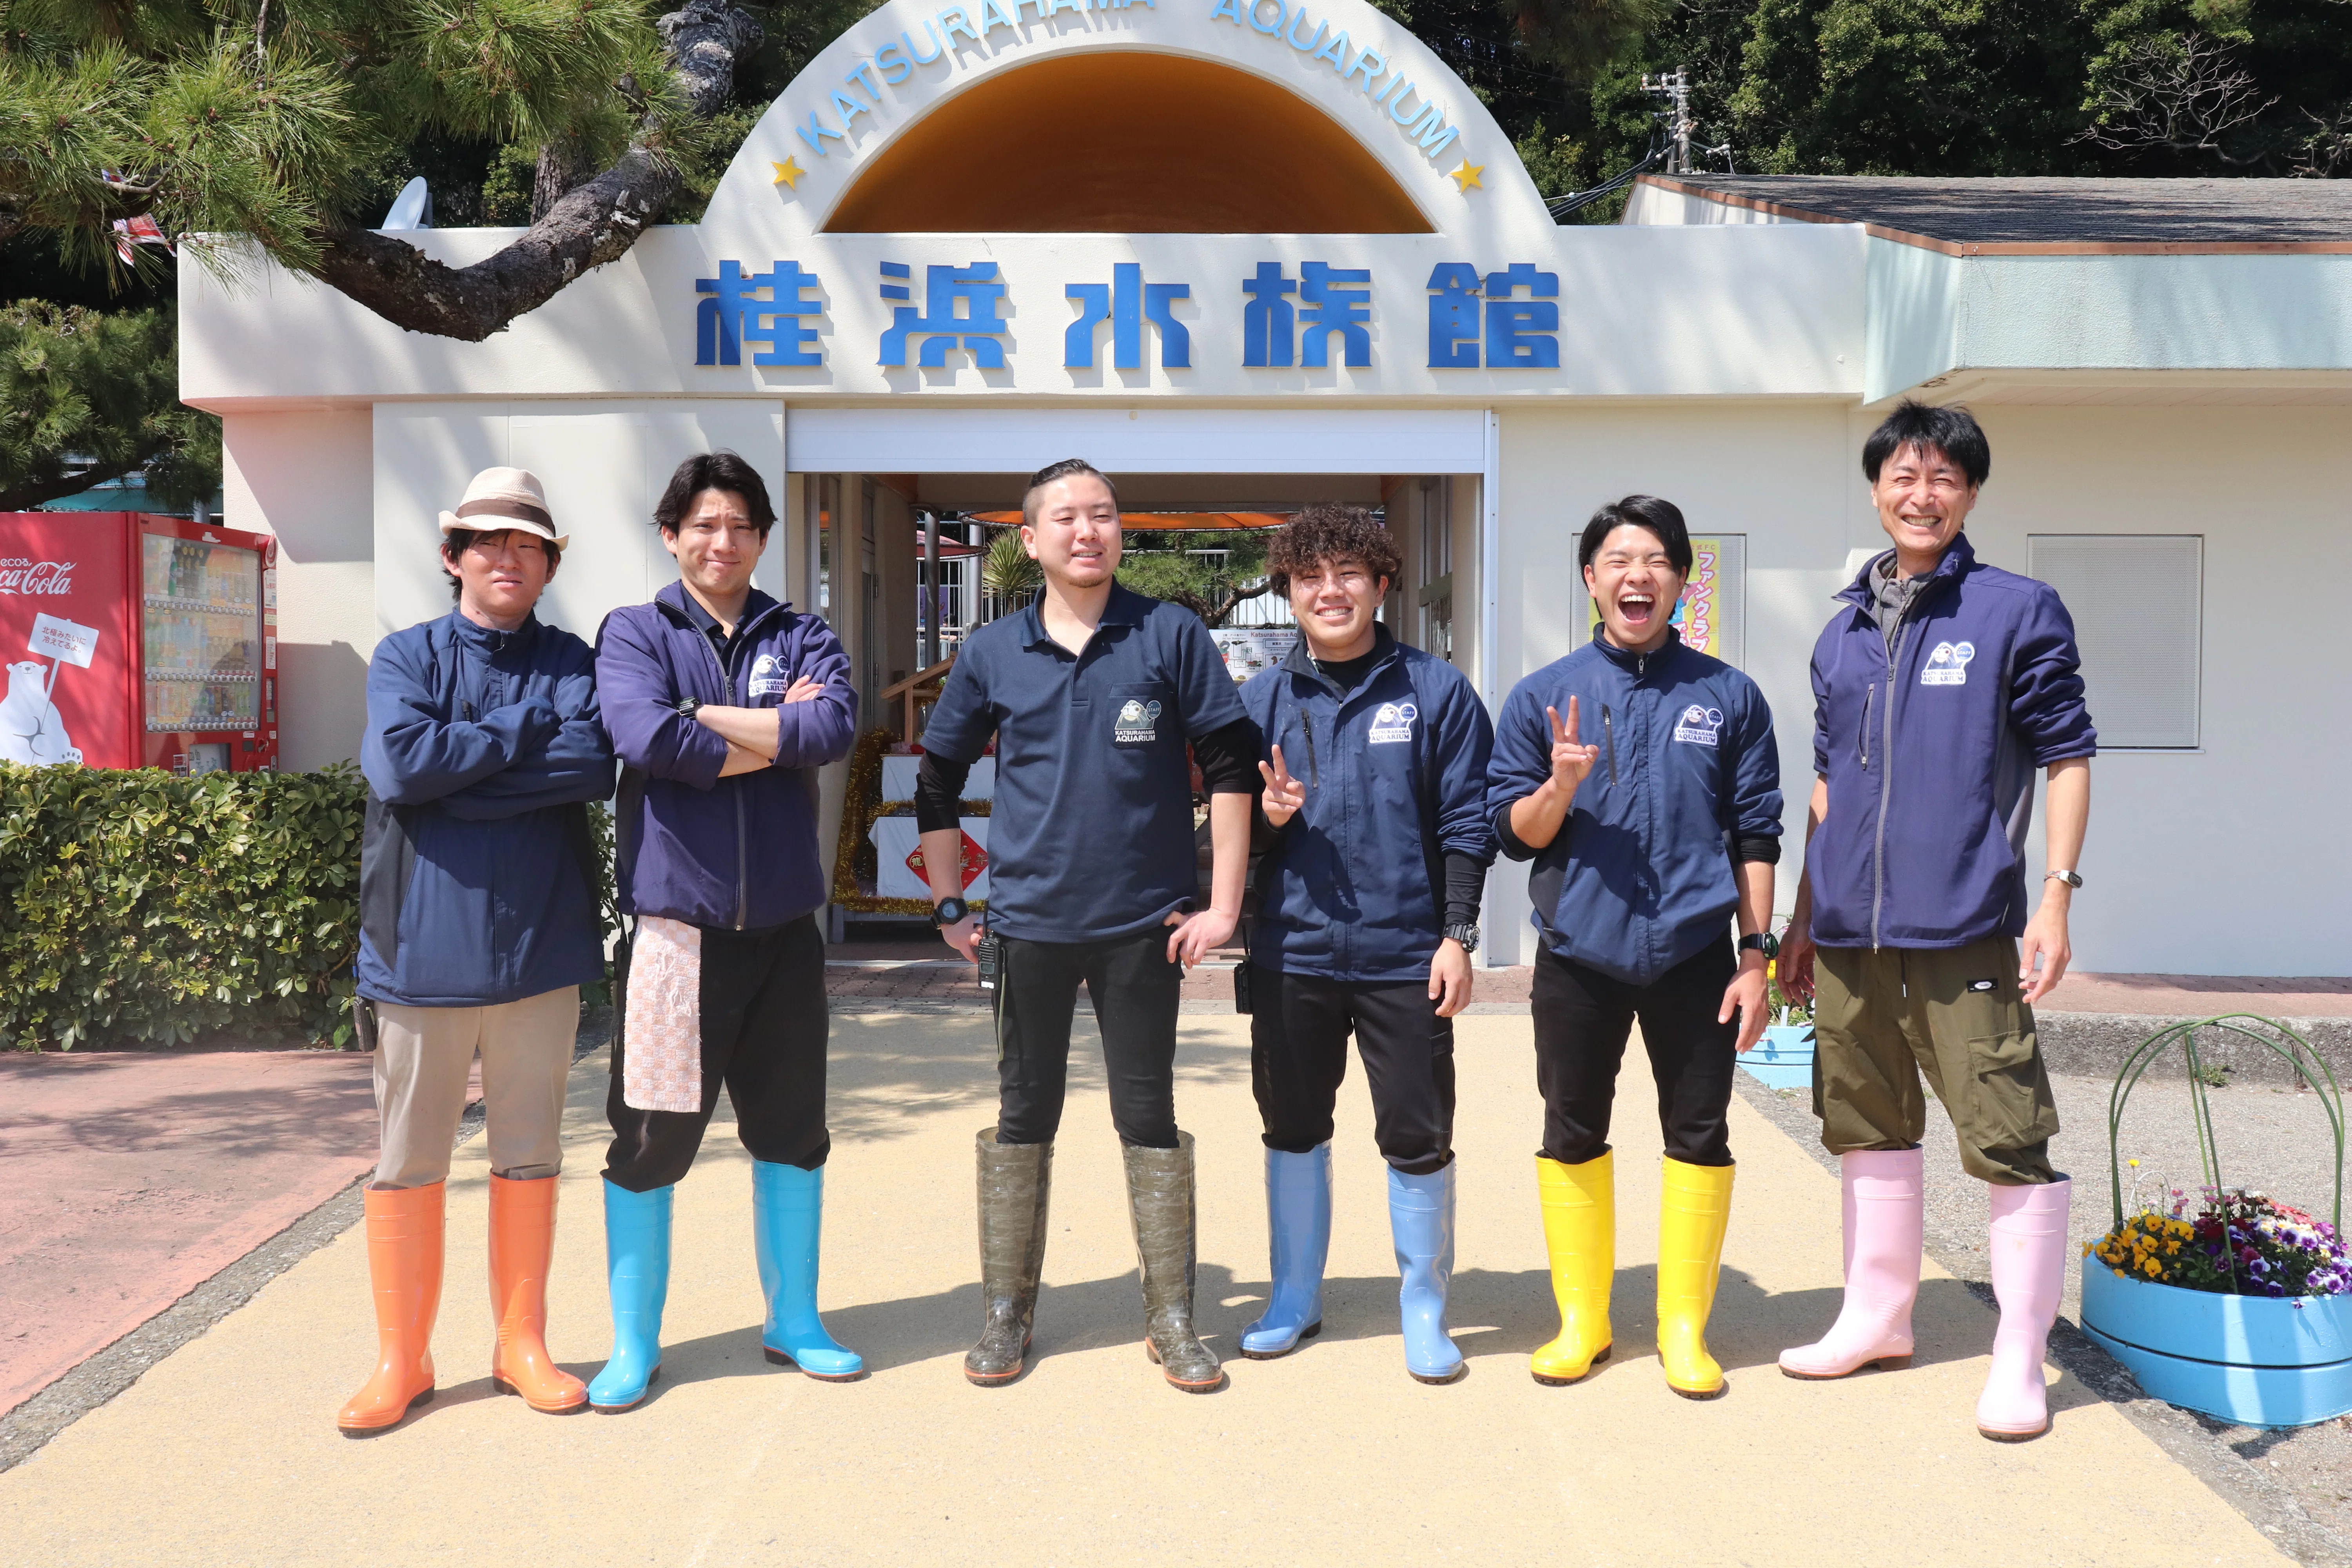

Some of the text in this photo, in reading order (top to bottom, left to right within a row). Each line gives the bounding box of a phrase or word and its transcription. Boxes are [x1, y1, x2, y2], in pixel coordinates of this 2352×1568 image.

[795, 0, 1460, 158] KATSURAH AQUARIUM
[694, 259, 1561, 370] 桂浜水族館
[1691, 552, 1716, 653] ファンクラブ
[42, 626, 87, 645] 北極みたいに
[42, 635, 82, 653] 冷えてるよ。
[1677, 729, 1716, 737] KATSURAHAMA
[1678, 734, 1716, 743] AQUARIUM
[911, 857, 922, 867] 龍
